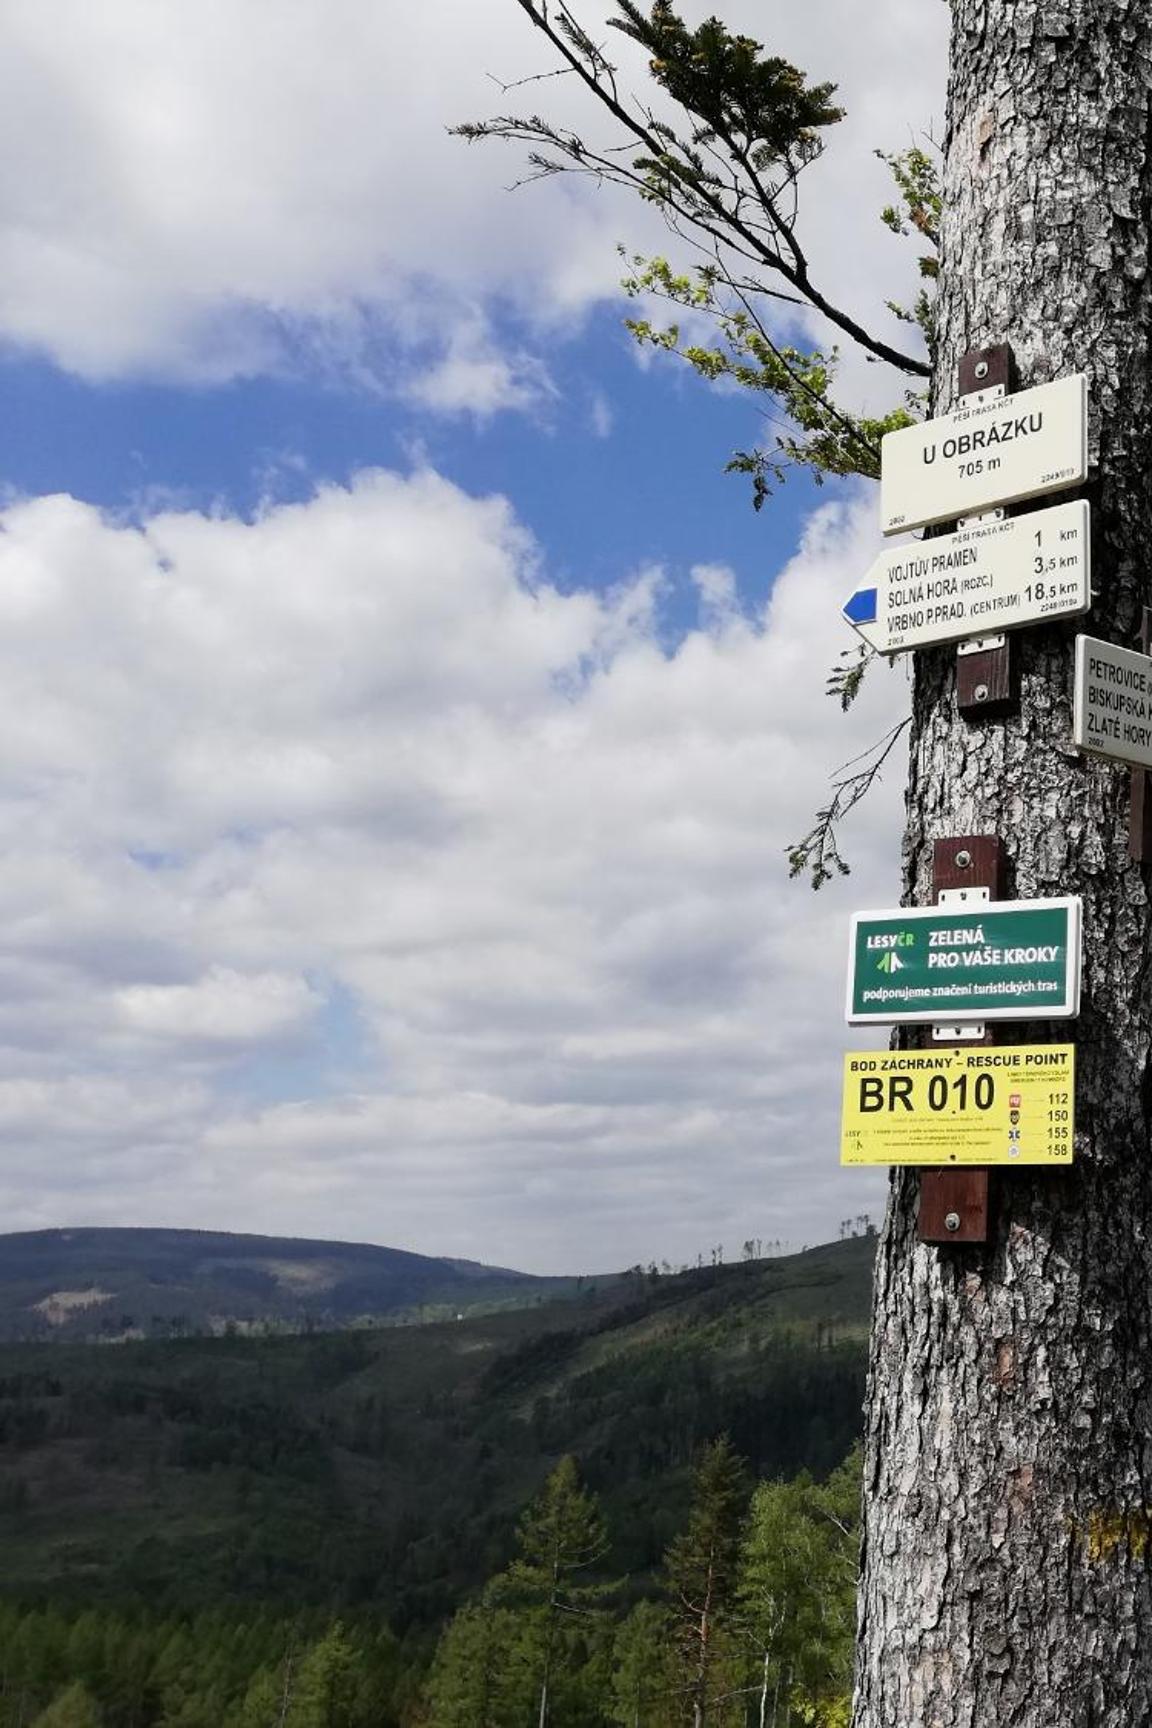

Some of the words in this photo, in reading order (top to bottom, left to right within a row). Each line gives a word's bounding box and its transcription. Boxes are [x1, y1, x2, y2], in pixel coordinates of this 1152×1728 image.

[923, 446, 936, 465] U
[942, 412, 1043, 459] OBRÁZKU
[958, 461, 984, 479] 705
[988, 457, 1001, 470] m
[931, 547, 978, 573] PRAMEN
[1034, 530, 1043, 548] 1
[1059, 529, 1078, 542] km
[888, 582, 924, 609] SOLNÁ
[927, 577, 959, 600] HORA
[1034, 556, 1056, 574] 3,5
[1059, 555, 1078, 568] km
[887, 610, 924, 633] VRBNO
[970, 594, 1021, 618] (CENTRUM)
[1059, 582, 1078, 595] km
[1089, 658, 1146, 692] PETROVICE
[1088, 686, 1146, 719] BISKUPSKÁ
[1087, 713, 1121, 742] ZLATÉ
[1123, 725, 1152, 747] HORY
[928, 924, 985, 947] ZELENÁ
[928, 952, 959, 969] PRO
[964, 946, 1000, 968] VÁŠE
[1004, 946, 1059, 965] KROKY
[862, 986, 931, 1003] podporujeme
[932, 982, 972, 997] značení
[974, 979, 1035, 996] turistických
[1037, 980, 1058, 992] tras
[851, 1060, 877, 1072] BOD
[881, 1057, 952, 1071] ZÁCHRANY
[967, 1054, 1021, 1067] RESCUE
[1025, 1053, 1068, 1065] POINT
[859, 1076, 914, 1113] BR
[928, 1073, 995, 1111] 010
[1048, 1093, 1068, 1105] 112
[1047, 1110, 1068, 1122] 150
[1047, 1127, 1068, 1139] 155
[1047, 1144, 1068, 1156] 158
